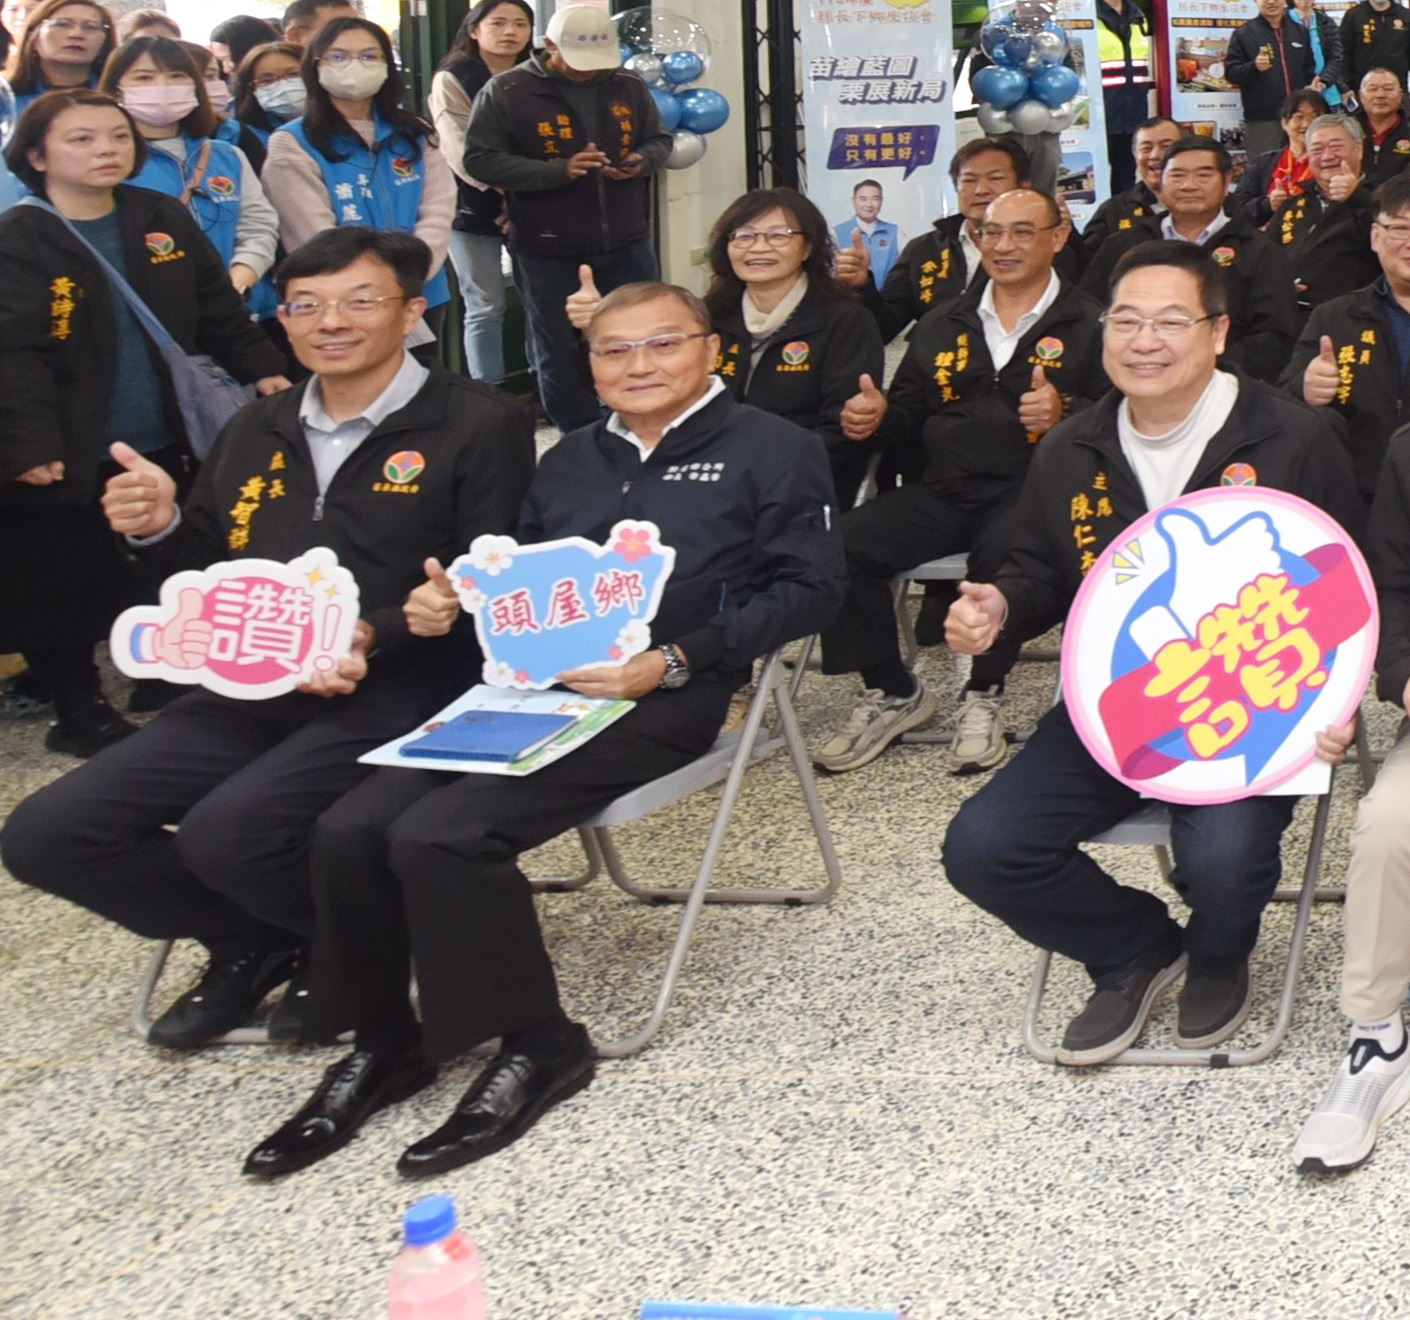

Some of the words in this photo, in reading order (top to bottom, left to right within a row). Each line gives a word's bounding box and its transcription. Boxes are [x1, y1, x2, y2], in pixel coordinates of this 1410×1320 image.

[808, 55, 919, 81] 苗繪藍圖
[838, 79, 948, 105] 栗展新局
[490, 571, 646, 635] 頭屋鄉
[1142, 573, 1327, 760] 讚
